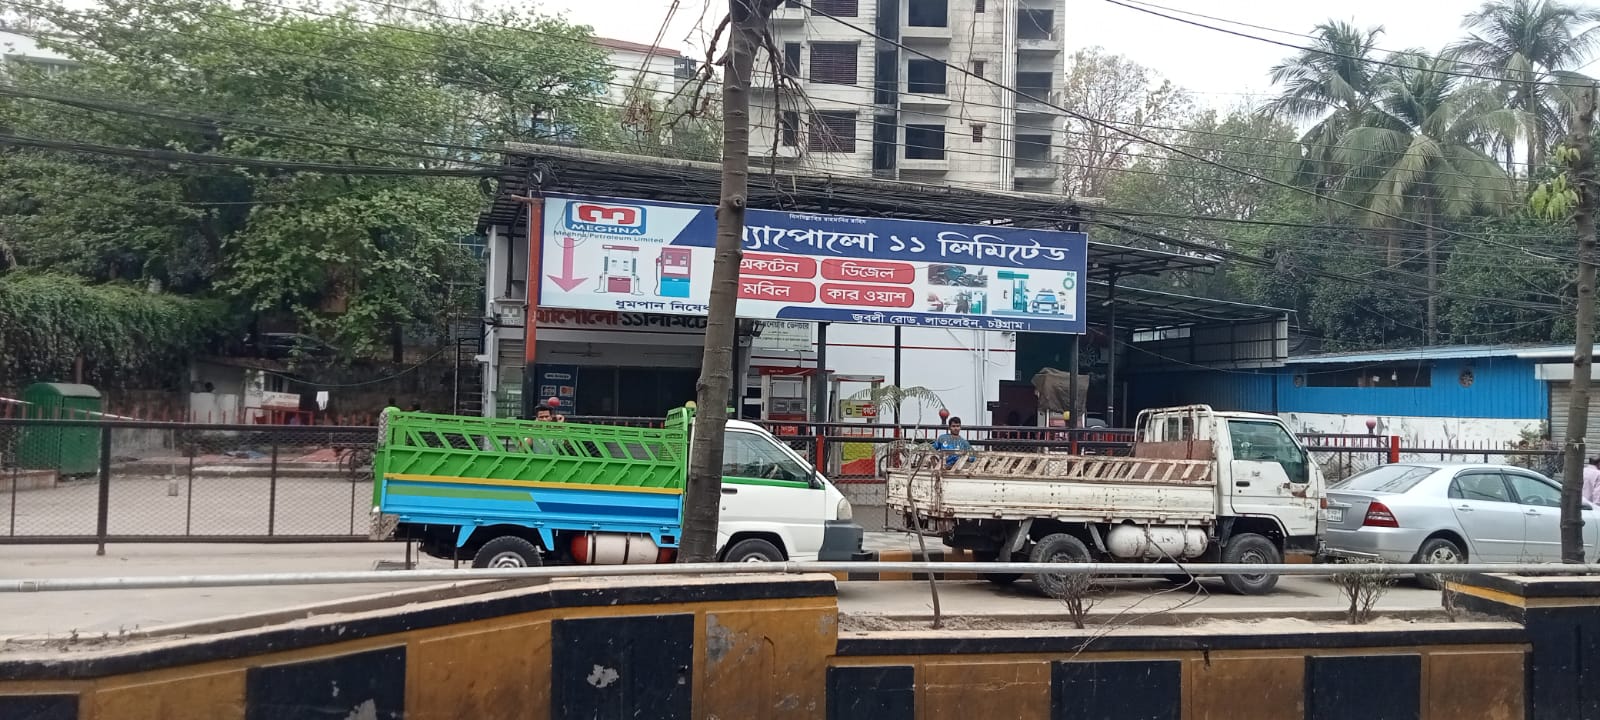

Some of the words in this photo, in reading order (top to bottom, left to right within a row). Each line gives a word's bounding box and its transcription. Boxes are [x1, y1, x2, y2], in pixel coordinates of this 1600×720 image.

[571, 224, 641, 235] MEGHNA
[590, 233, 631, 241] Petroleum
[889, 234, 926, 253] ১১
[936, 231, 1070, 265] লিমিটেড
[740, 258, 800, 273] অকটেন
[841, 262, 895, 279] ডিজেল
[742, 281, 791, 297] মবিল
[827, 288, 860, 301] কার
[863, 290, 907, 303] ওয়াশ
